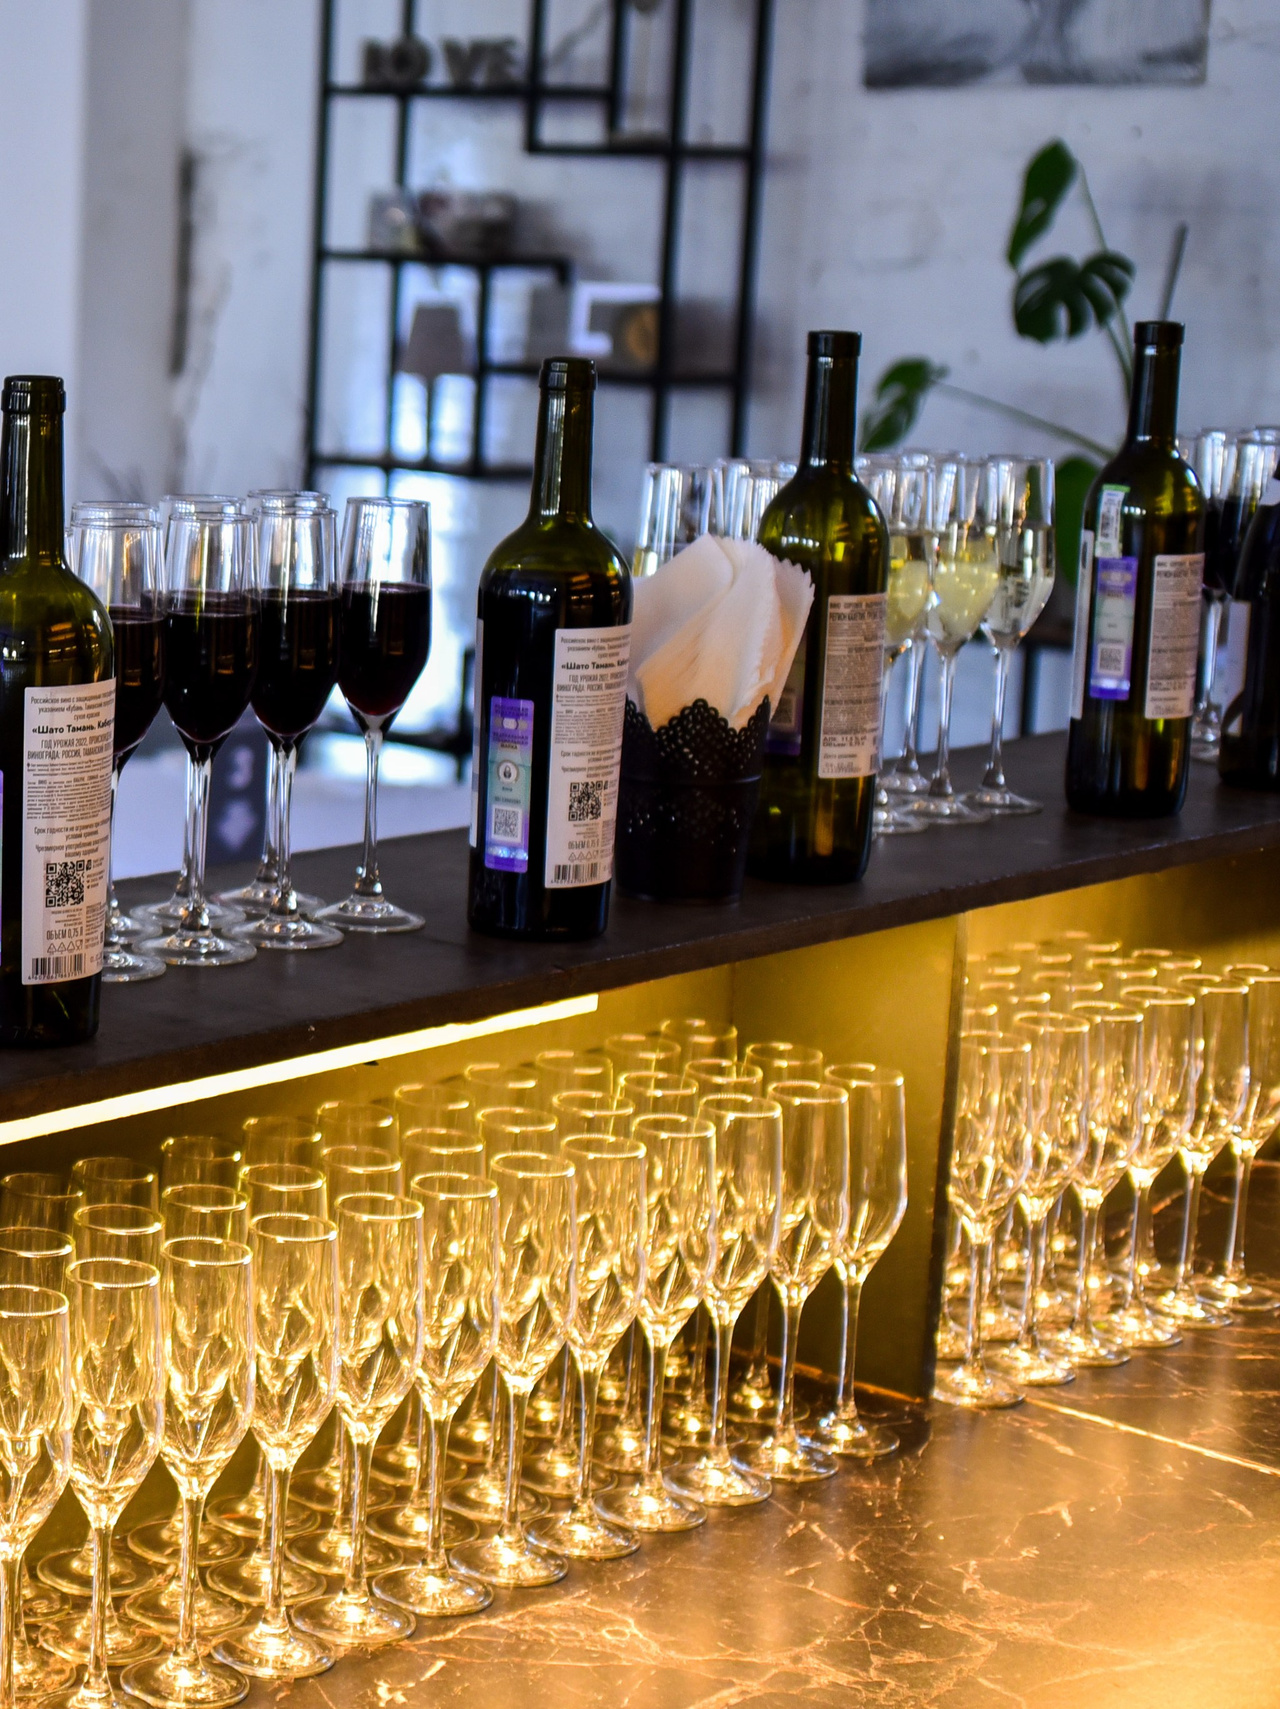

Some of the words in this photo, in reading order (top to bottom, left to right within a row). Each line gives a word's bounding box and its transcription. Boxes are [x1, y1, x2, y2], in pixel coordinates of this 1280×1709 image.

[561, 662, 589, 670] «Шато
[32, 725, 64, 734] «Шато
[66, 723, 96, 733] Тамань.
[41, 739, 52, 749] ГОД
[53, 737, 74, 748] УРОЖАЯ
[34, 826, 45, 835] Срок
[46, 929, 67, 940] ОБЪЕМ
